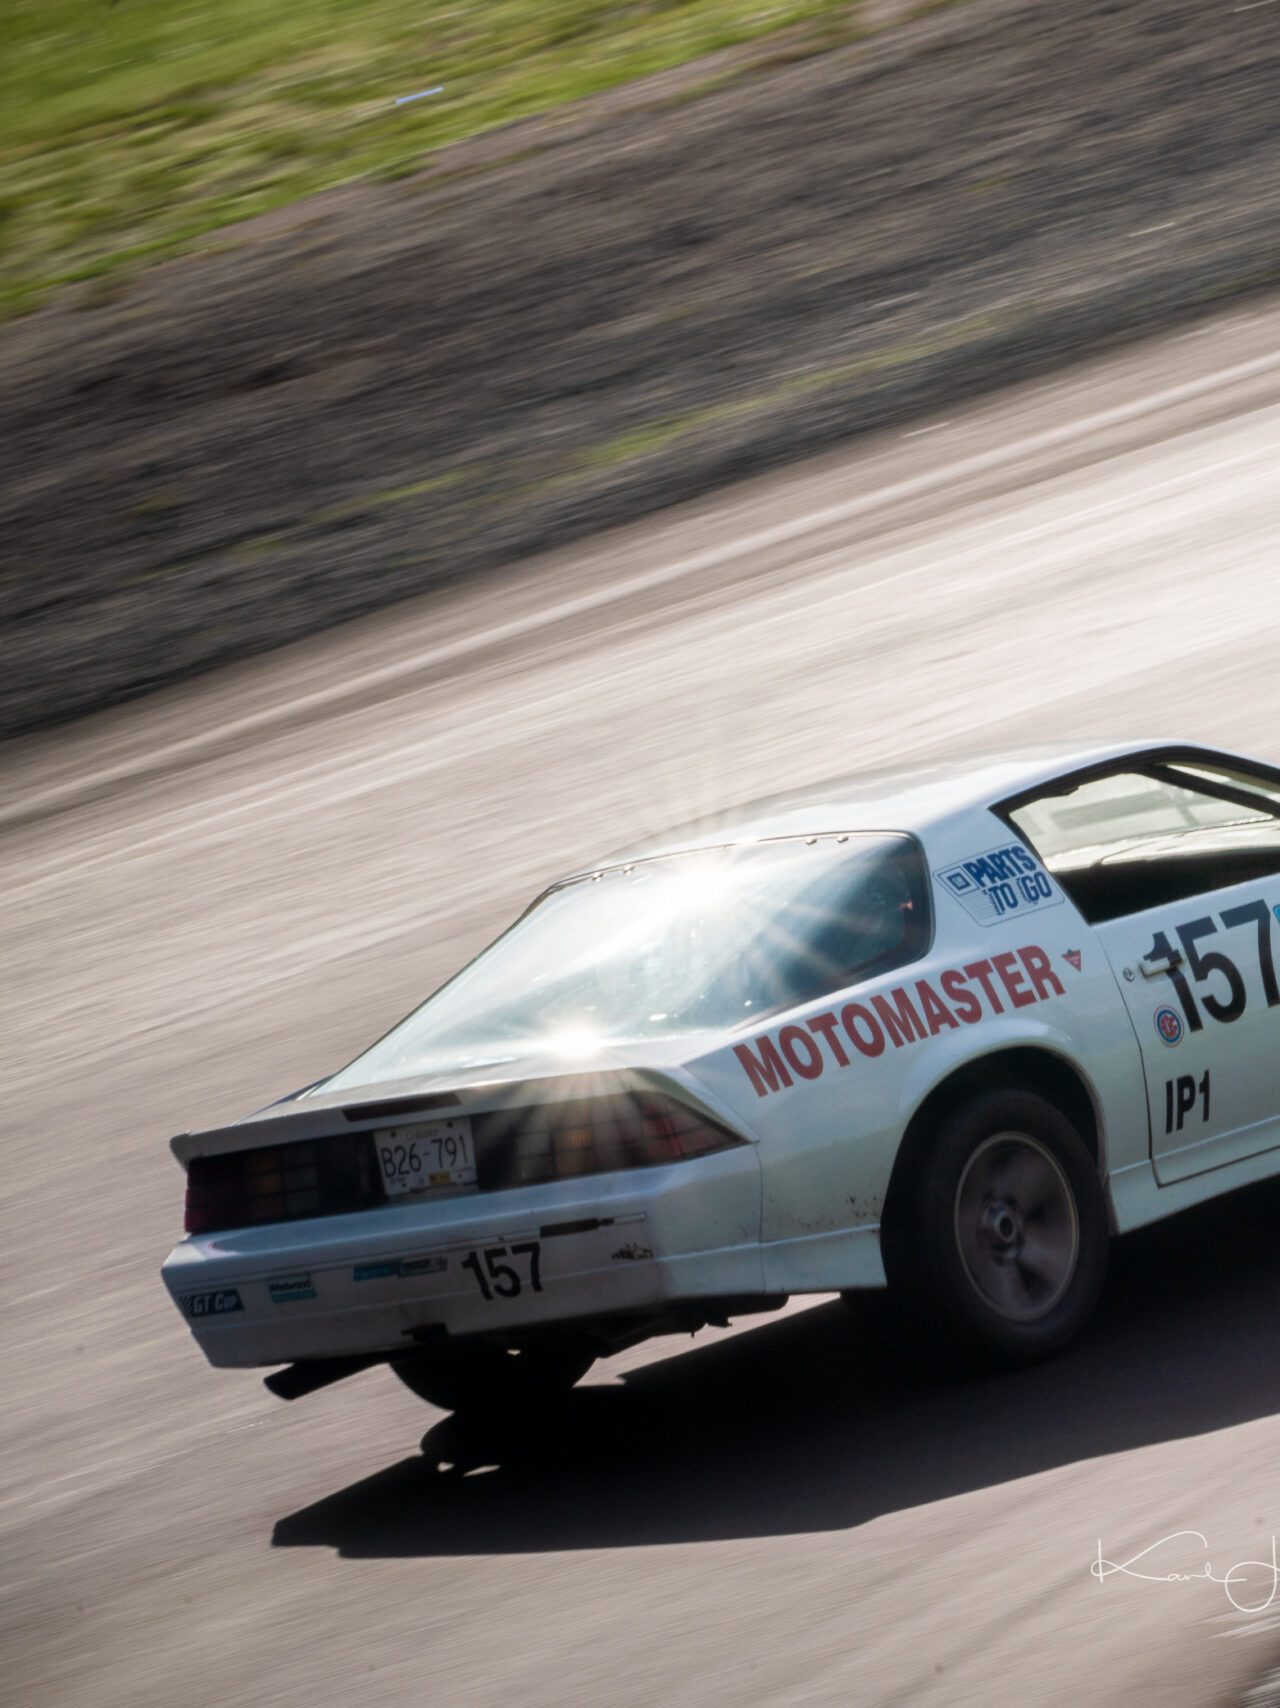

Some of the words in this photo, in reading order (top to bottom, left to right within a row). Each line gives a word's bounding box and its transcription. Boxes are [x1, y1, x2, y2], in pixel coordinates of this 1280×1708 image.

[963, 846, 1037, 888] PARTS
[986, 883, 1018, 915] TO
[1019, 871, 1052, 904] GO
[1143, 900, 1280, 1033] 157
[732, 945, 1066, 1098] MOTOMASTER
[1165, 1069, 1211, 1135] IP1
[381, 1133, 469, 1178] B26-791
[461, 1242, 543, 1301] 157
[192, 1296, 215, 1314] GT
